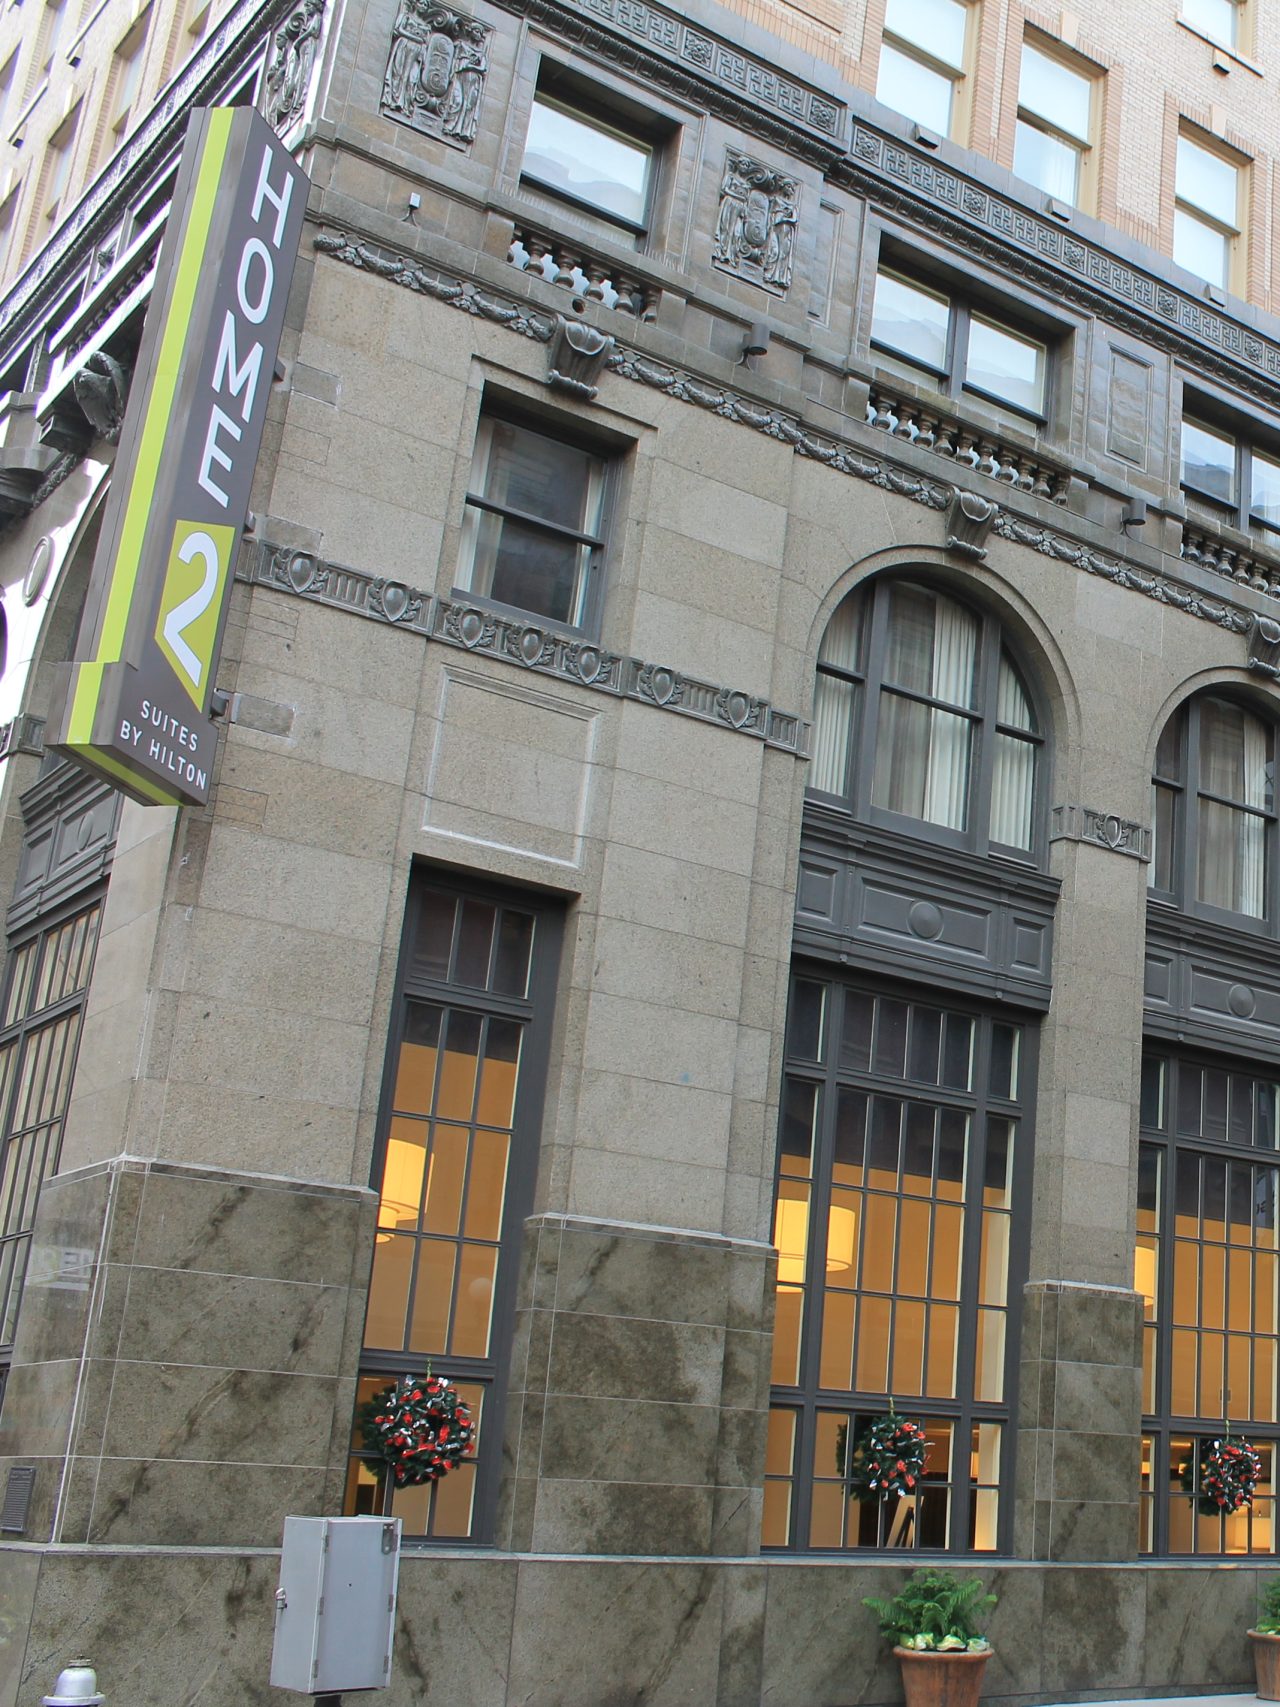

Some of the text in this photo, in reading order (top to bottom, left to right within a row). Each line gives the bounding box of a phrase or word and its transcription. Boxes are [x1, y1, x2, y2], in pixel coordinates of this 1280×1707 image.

[163, 144, 294, 688] HOME 2
[120, 719, 206, 790] BY HILTON
[141, 700, 198, 751] SUITES
